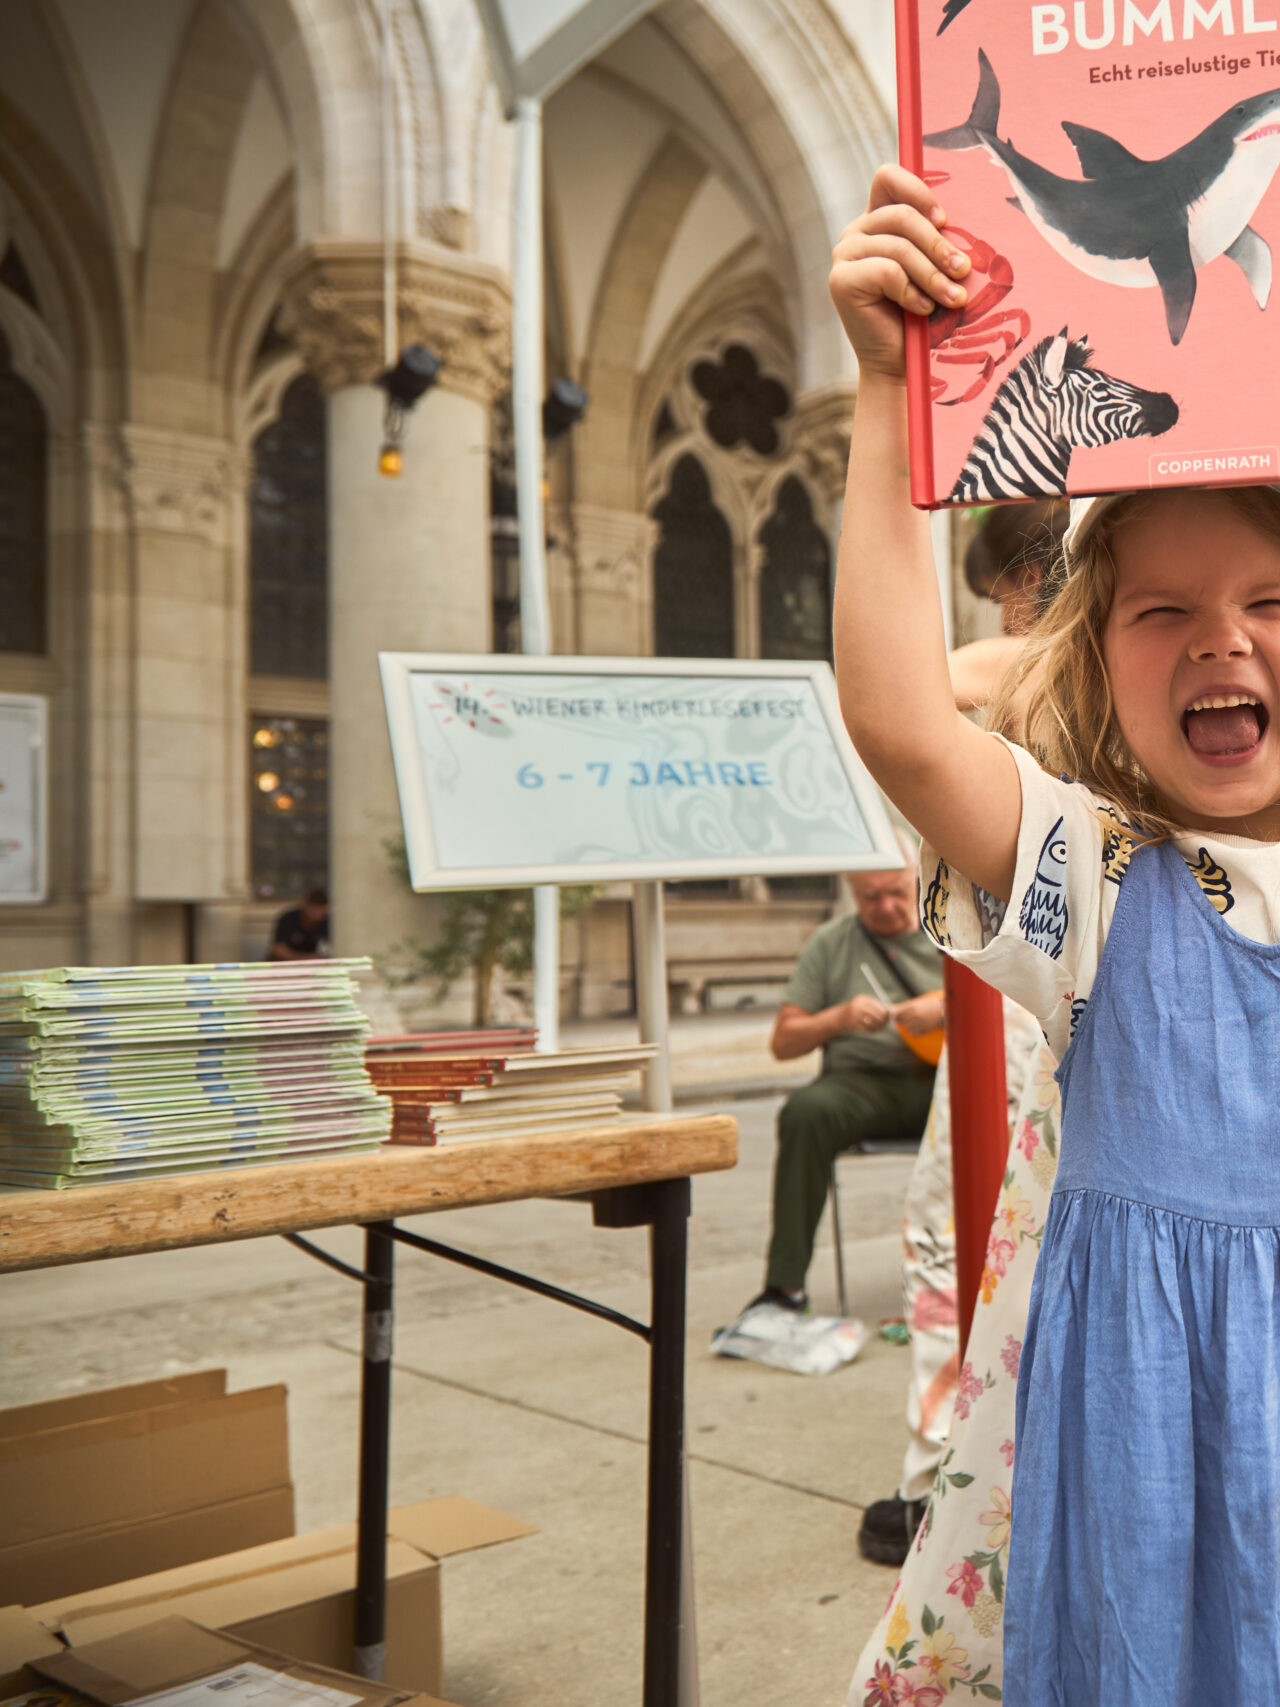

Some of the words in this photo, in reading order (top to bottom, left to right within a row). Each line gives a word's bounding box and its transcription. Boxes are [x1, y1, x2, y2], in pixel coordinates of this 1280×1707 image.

[1089, 64, 1133, 84] Echt
[1138, 56, 1251, 80] reiselustige
[1157, 454, 1271, 475] COPPENRATH
[454, 697, 488, 716] 14.
[512, 698, 606, 719] WIENER
[616, 697, 806, 720] KINDERLESEFEST
[516, 763, 544, 790] 6
[585, 763, 612, 788] 7
[627, 761, 774, 788] JAHRE
